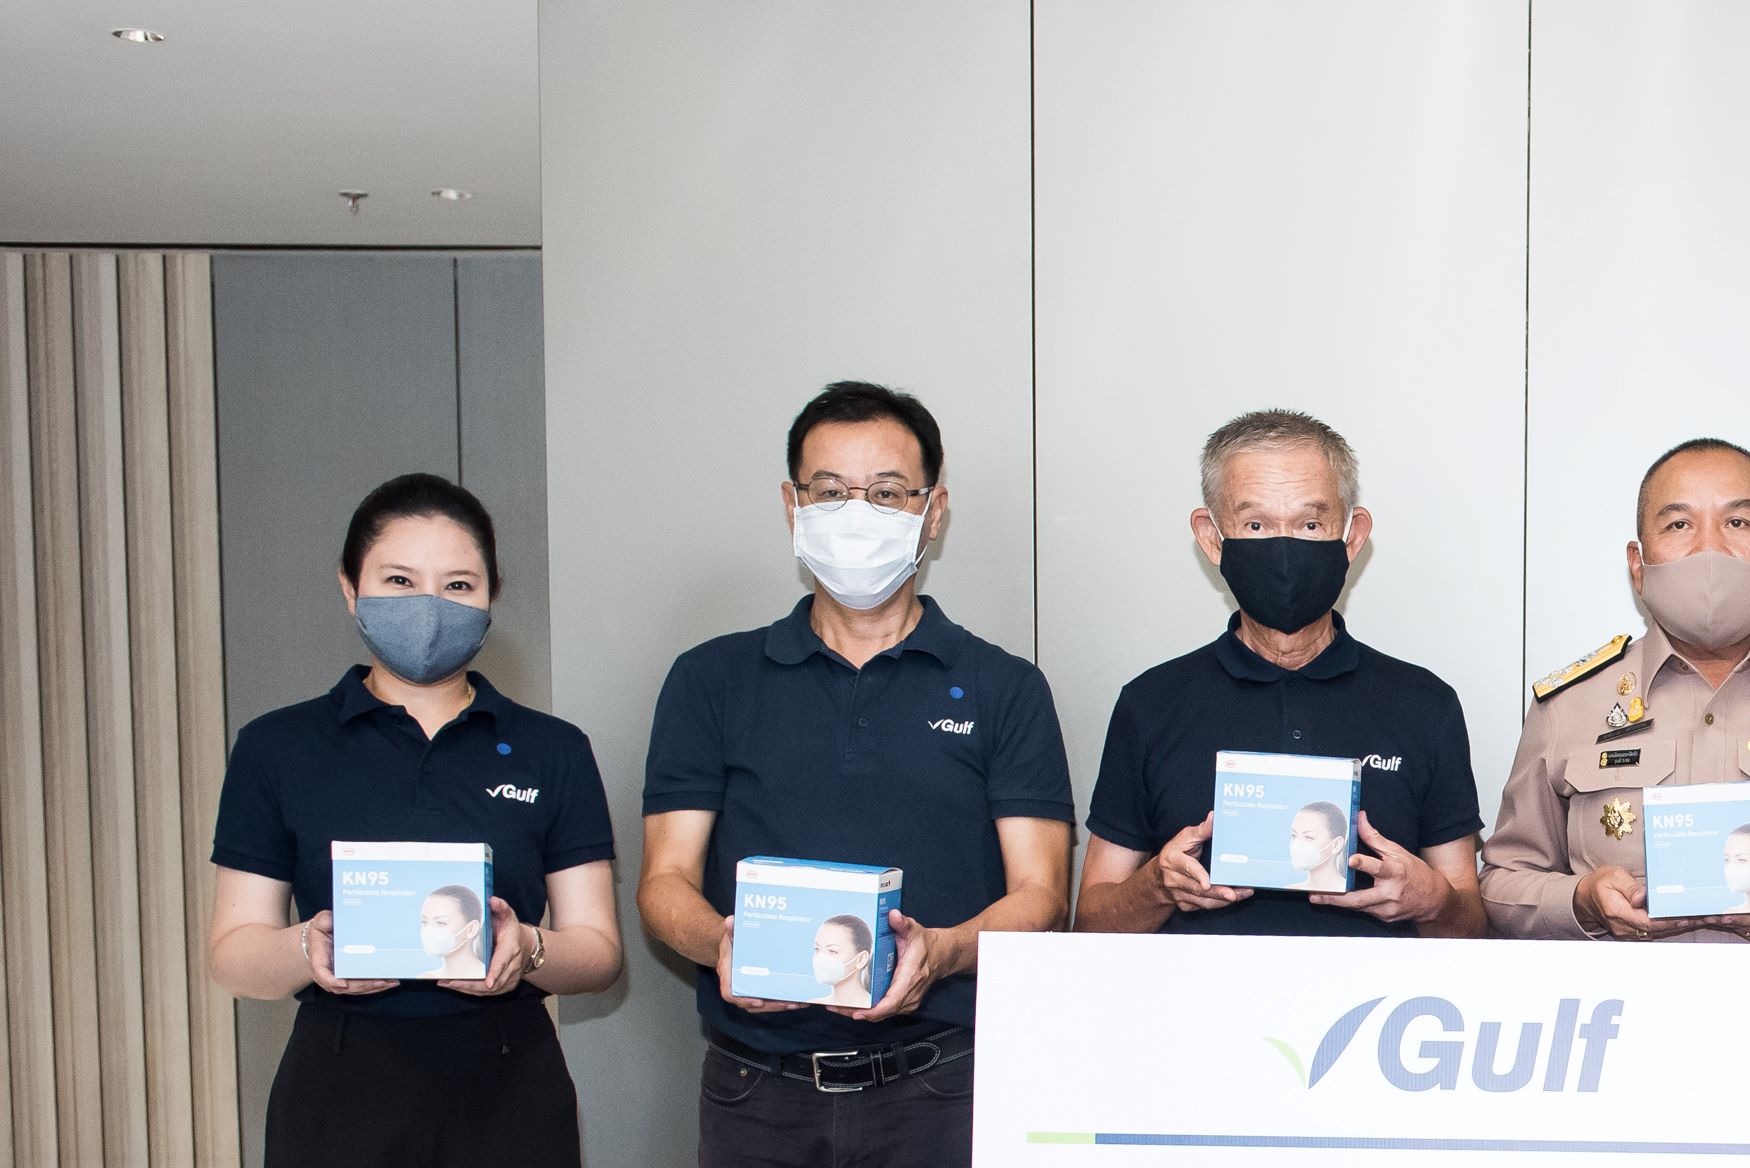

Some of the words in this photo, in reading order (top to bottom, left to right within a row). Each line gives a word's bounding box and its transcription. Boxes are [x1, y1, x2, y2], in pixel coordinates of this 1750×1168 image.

[941, 719, 975, 735] Gulf
[1370, 755, 1402, 771] Gulf
[502, 784, 539, 803] Gulf
[1223, 783, 1265, 798] KN95
[1653, 814, 1694, 829] KN95
[342, 871, 390, 885] KN95
[744, 894, 787, 911] KN95
[1377, 995, 1625, 1093] Gulf
